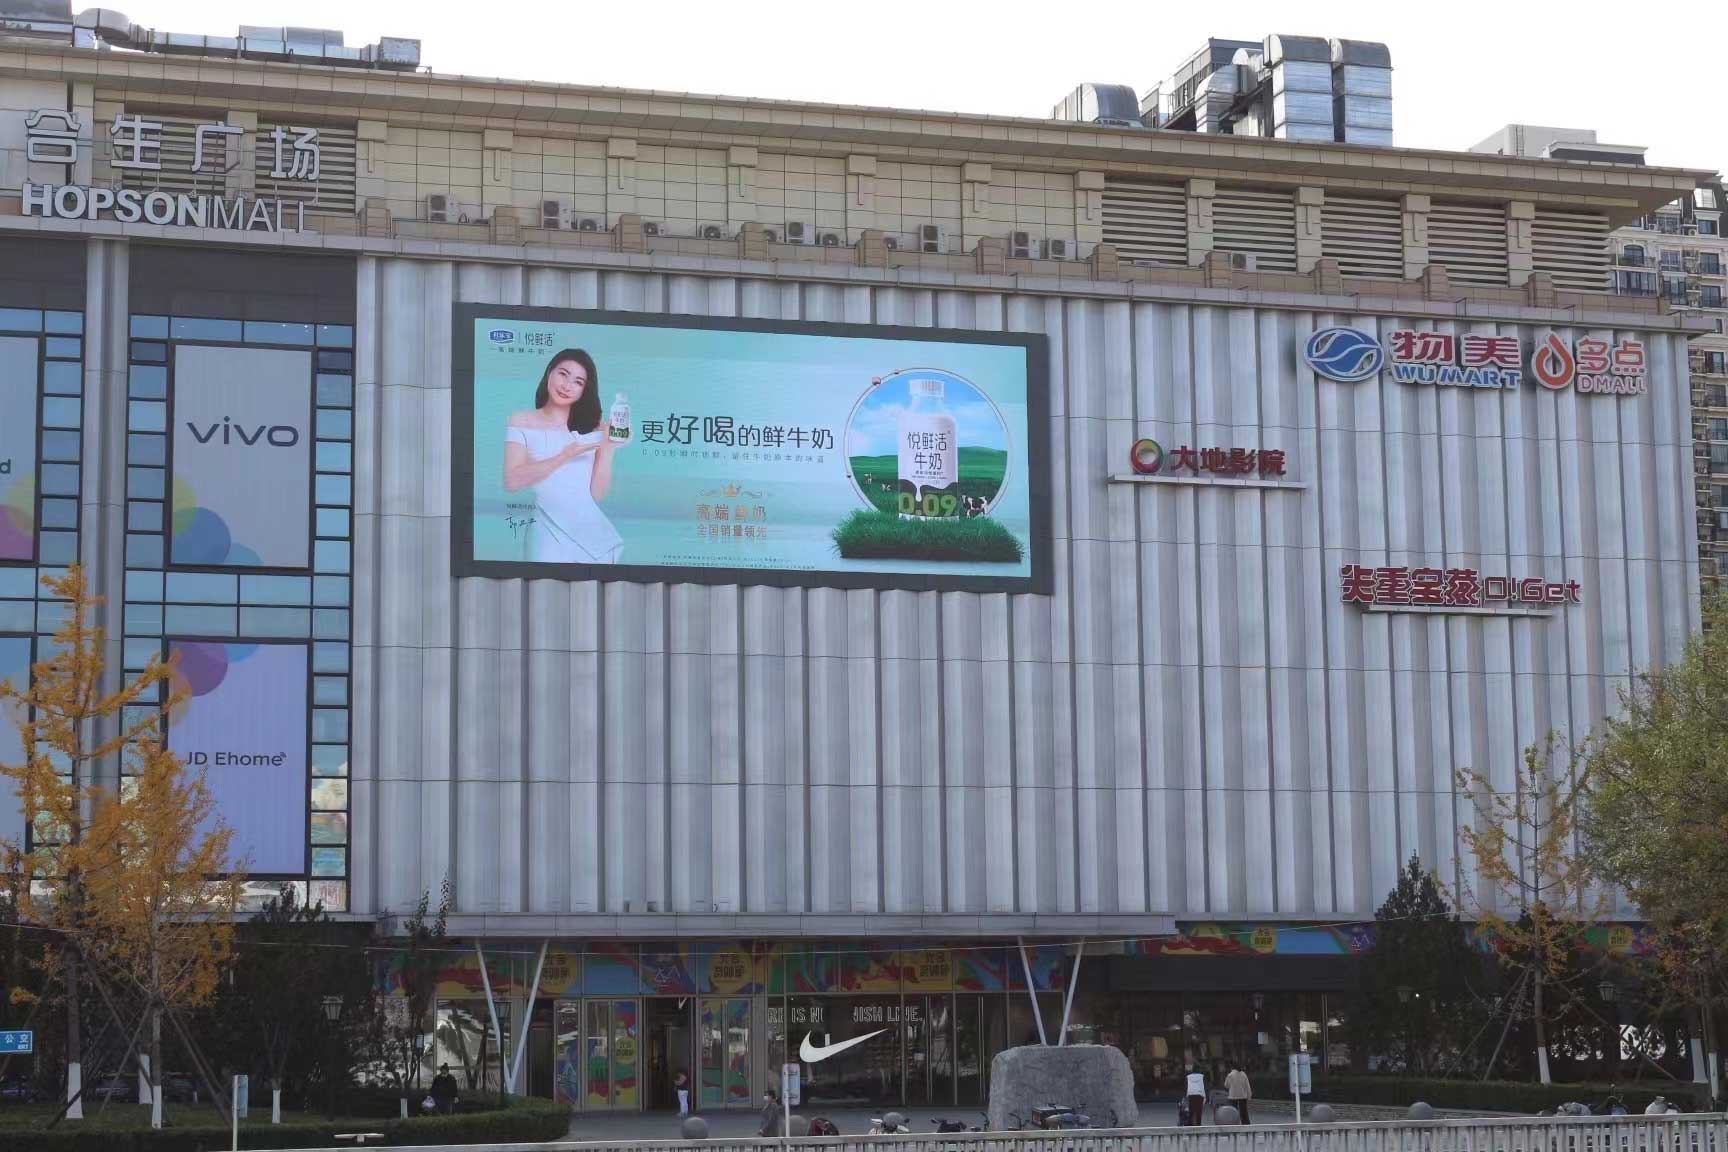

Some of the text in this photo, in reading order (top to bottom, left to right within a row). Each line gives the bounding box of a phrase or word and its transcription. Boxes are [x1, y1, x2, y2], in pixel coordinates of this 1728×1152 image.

[25, 108, 320, 181] 合生广场
[21, 182, 314, 233] HOPSONMALL
[524, 330, 554, 347] 悦鲜活
[1391, 331, 1521, 367] 物美
[1575, 336, 1646, 375] 多点
[1391, 363, 1521, 390] WUMART
[1576, 374, 1647, 395] DMALL
[186, 415, 299, 447] vivo
[640, 413, 834, 449] 更好喝的鲜牛奶
[907, 432, 947, 451] 悦鲜活
[914, 452, 943, 470] 牛奶
[1169, 445, 1287, 476] 大地影院
[186, 752, 283, 767] JD Ehome
